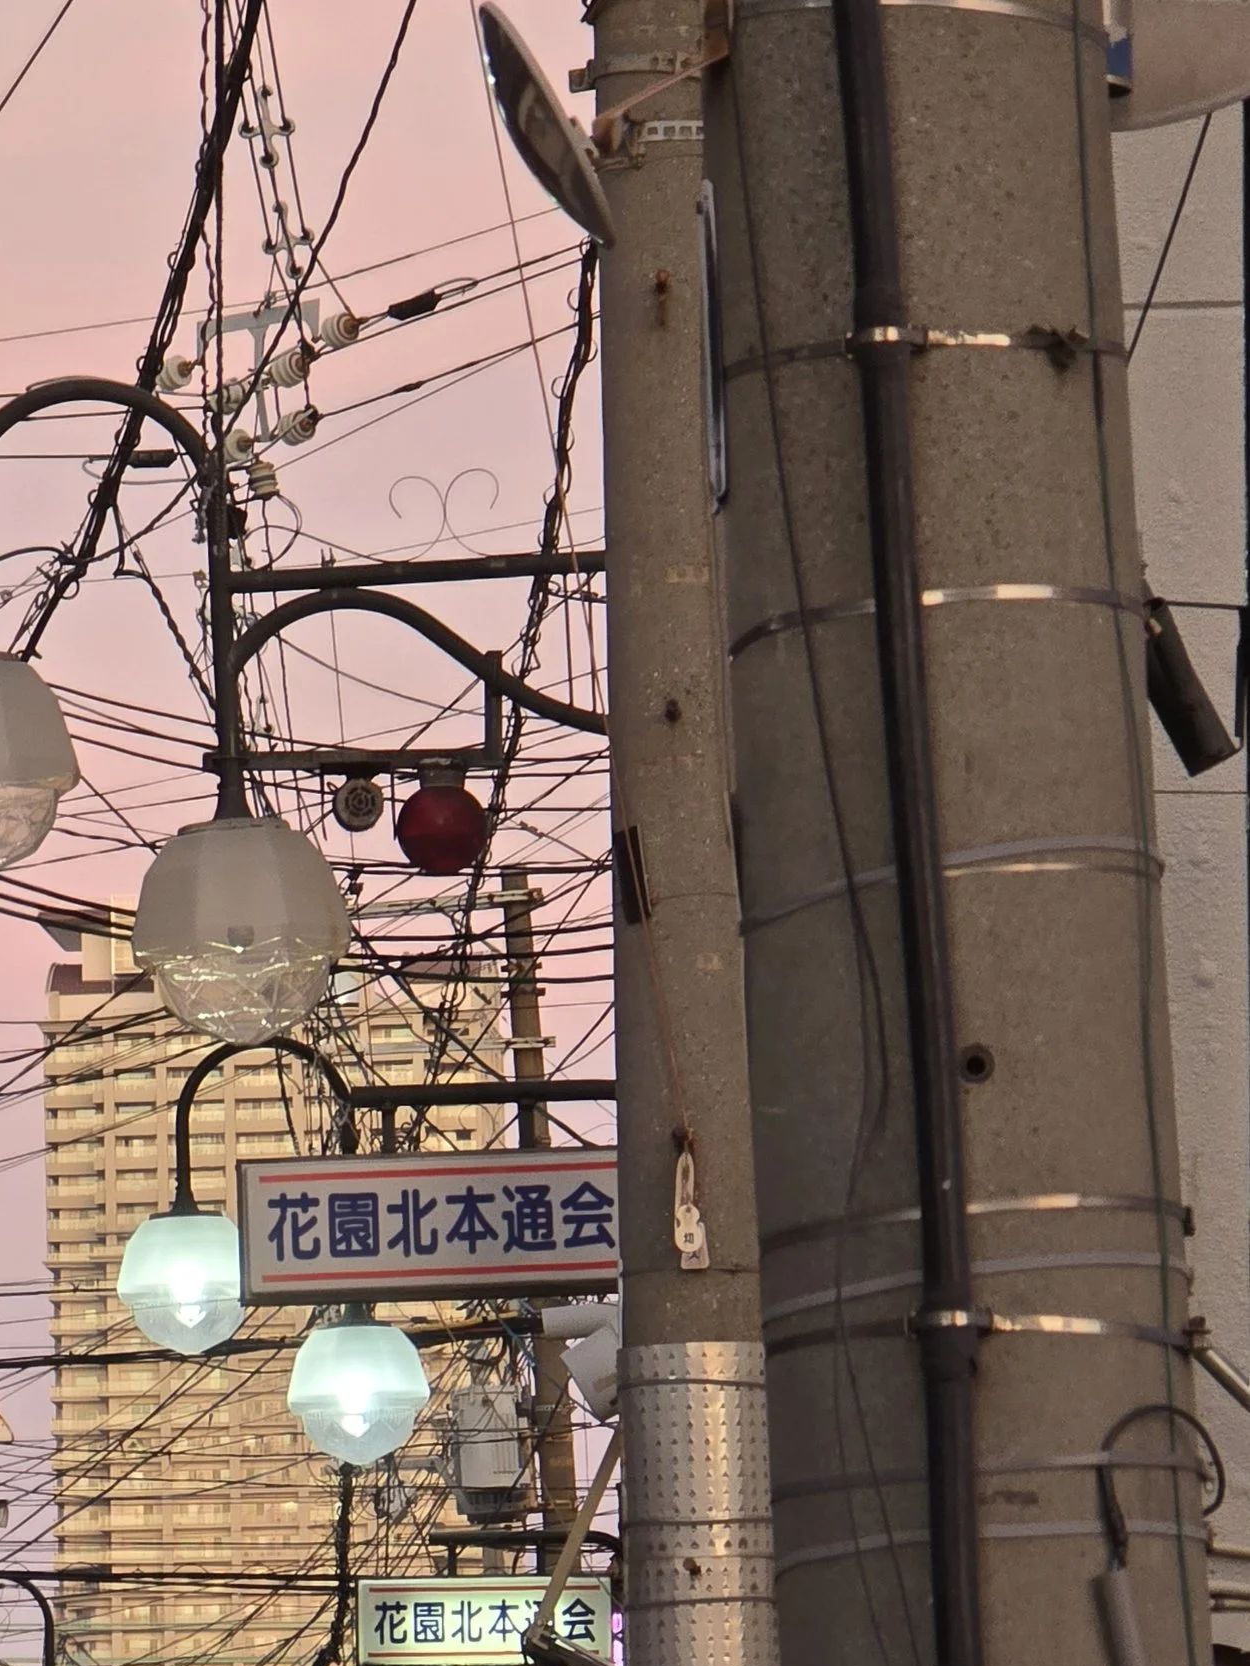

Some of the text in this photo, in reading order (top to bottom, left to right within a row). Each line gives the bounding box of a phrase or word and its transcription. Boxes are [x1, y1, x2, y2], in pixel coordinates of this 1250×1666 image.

[266, 1181, 615, 1260] 花園北本通会
